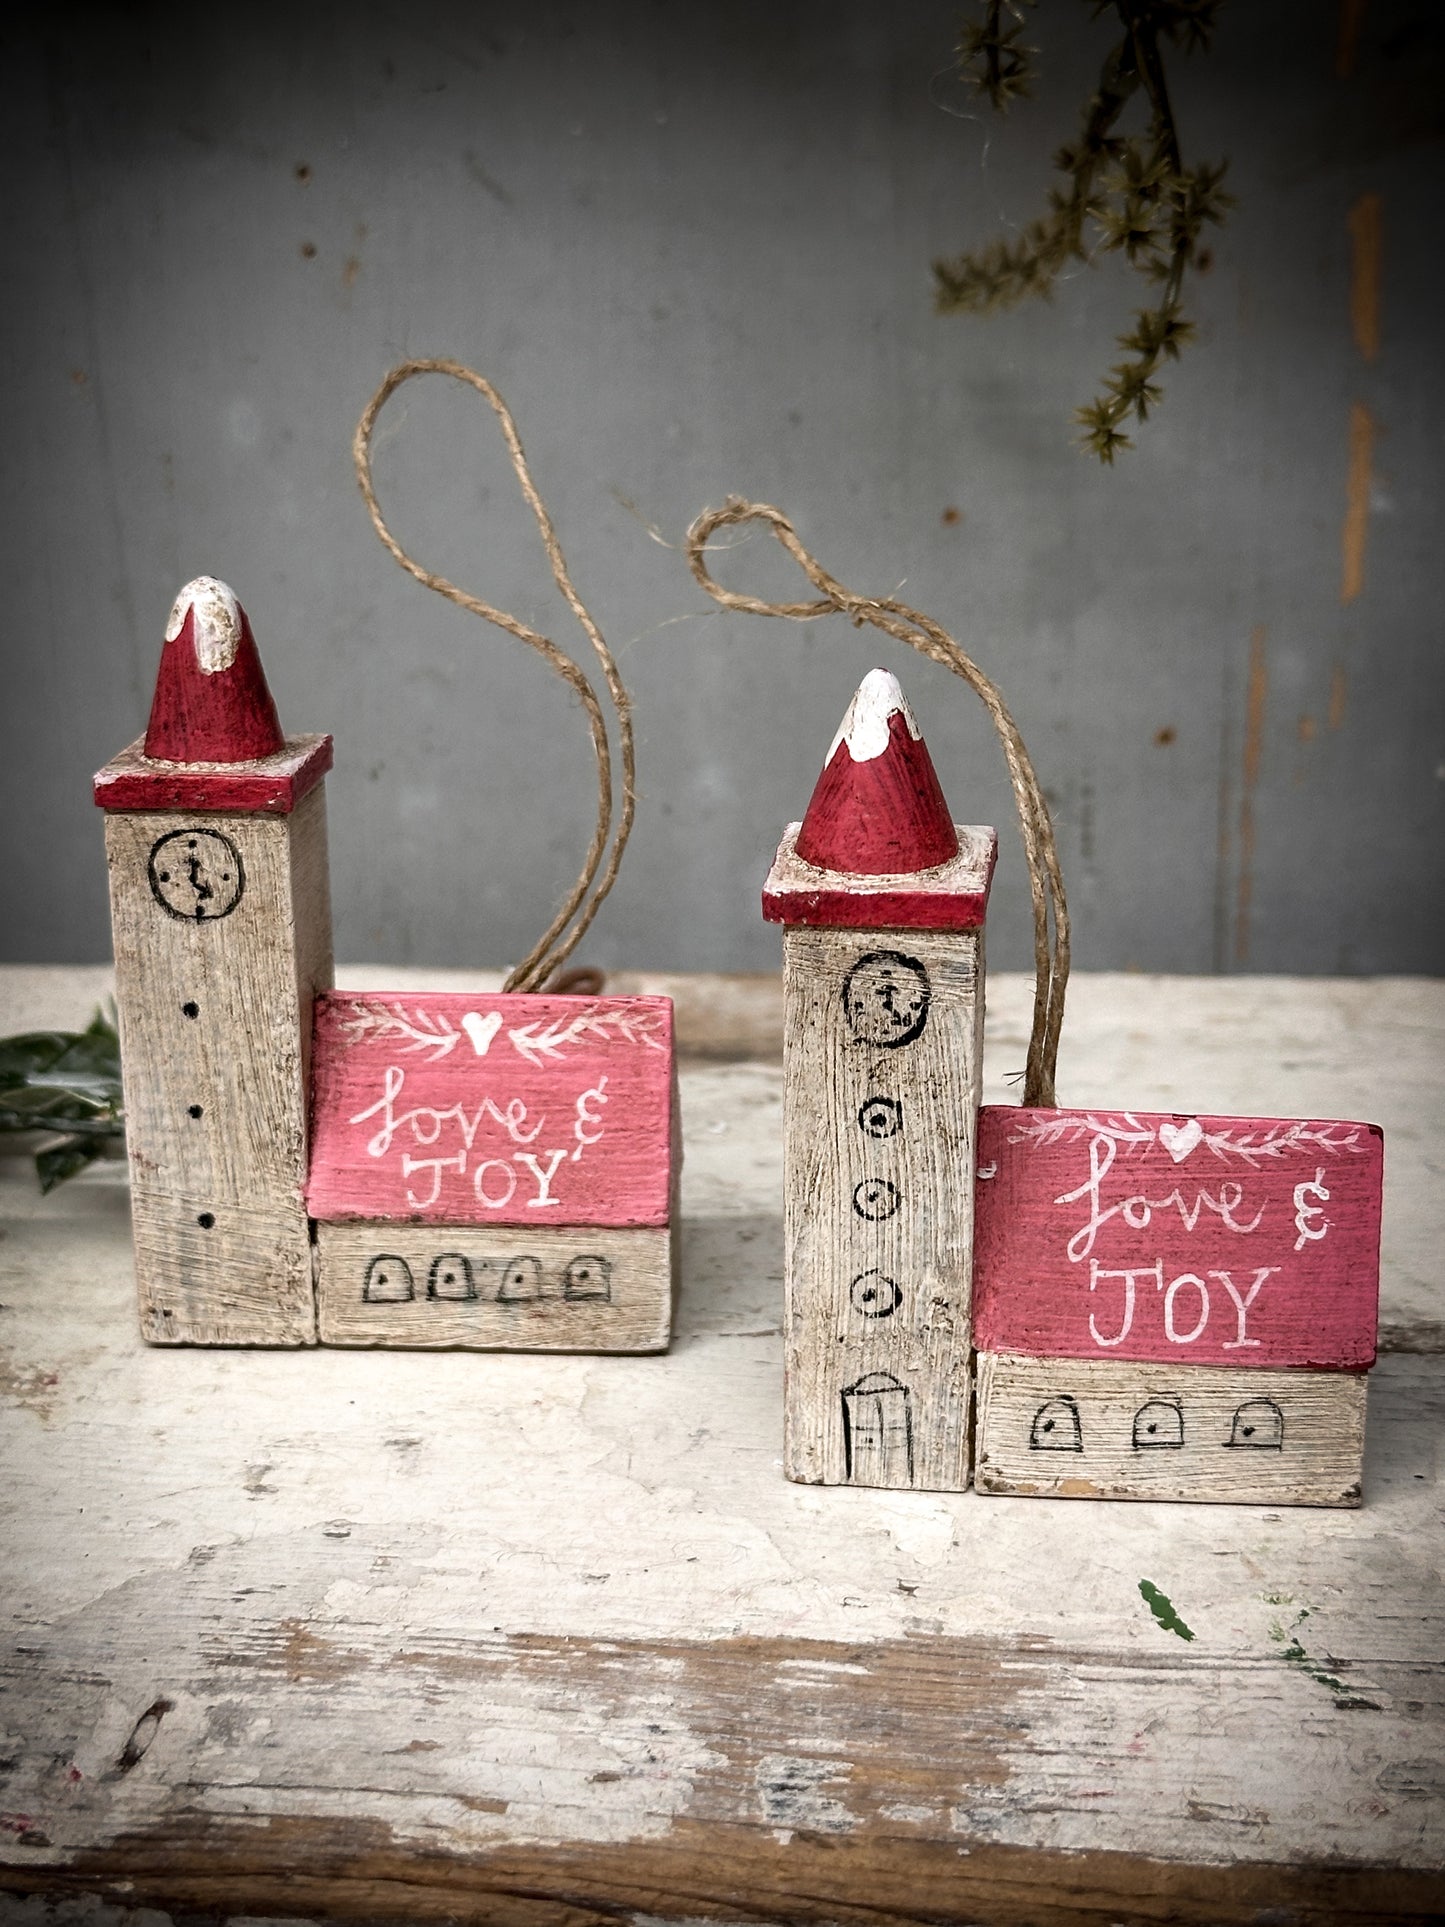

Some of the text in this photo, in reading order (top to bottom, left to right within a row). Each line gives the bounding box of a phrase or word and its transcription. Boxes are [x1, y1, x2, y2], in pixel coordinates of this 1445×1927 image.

[571, 1075, 608, 1161] &
[403, 1149, 568, 1209] JOY
[1293, 1166, 1335, 1251] &
[1089, 1257, 1282, 1348] JOY
